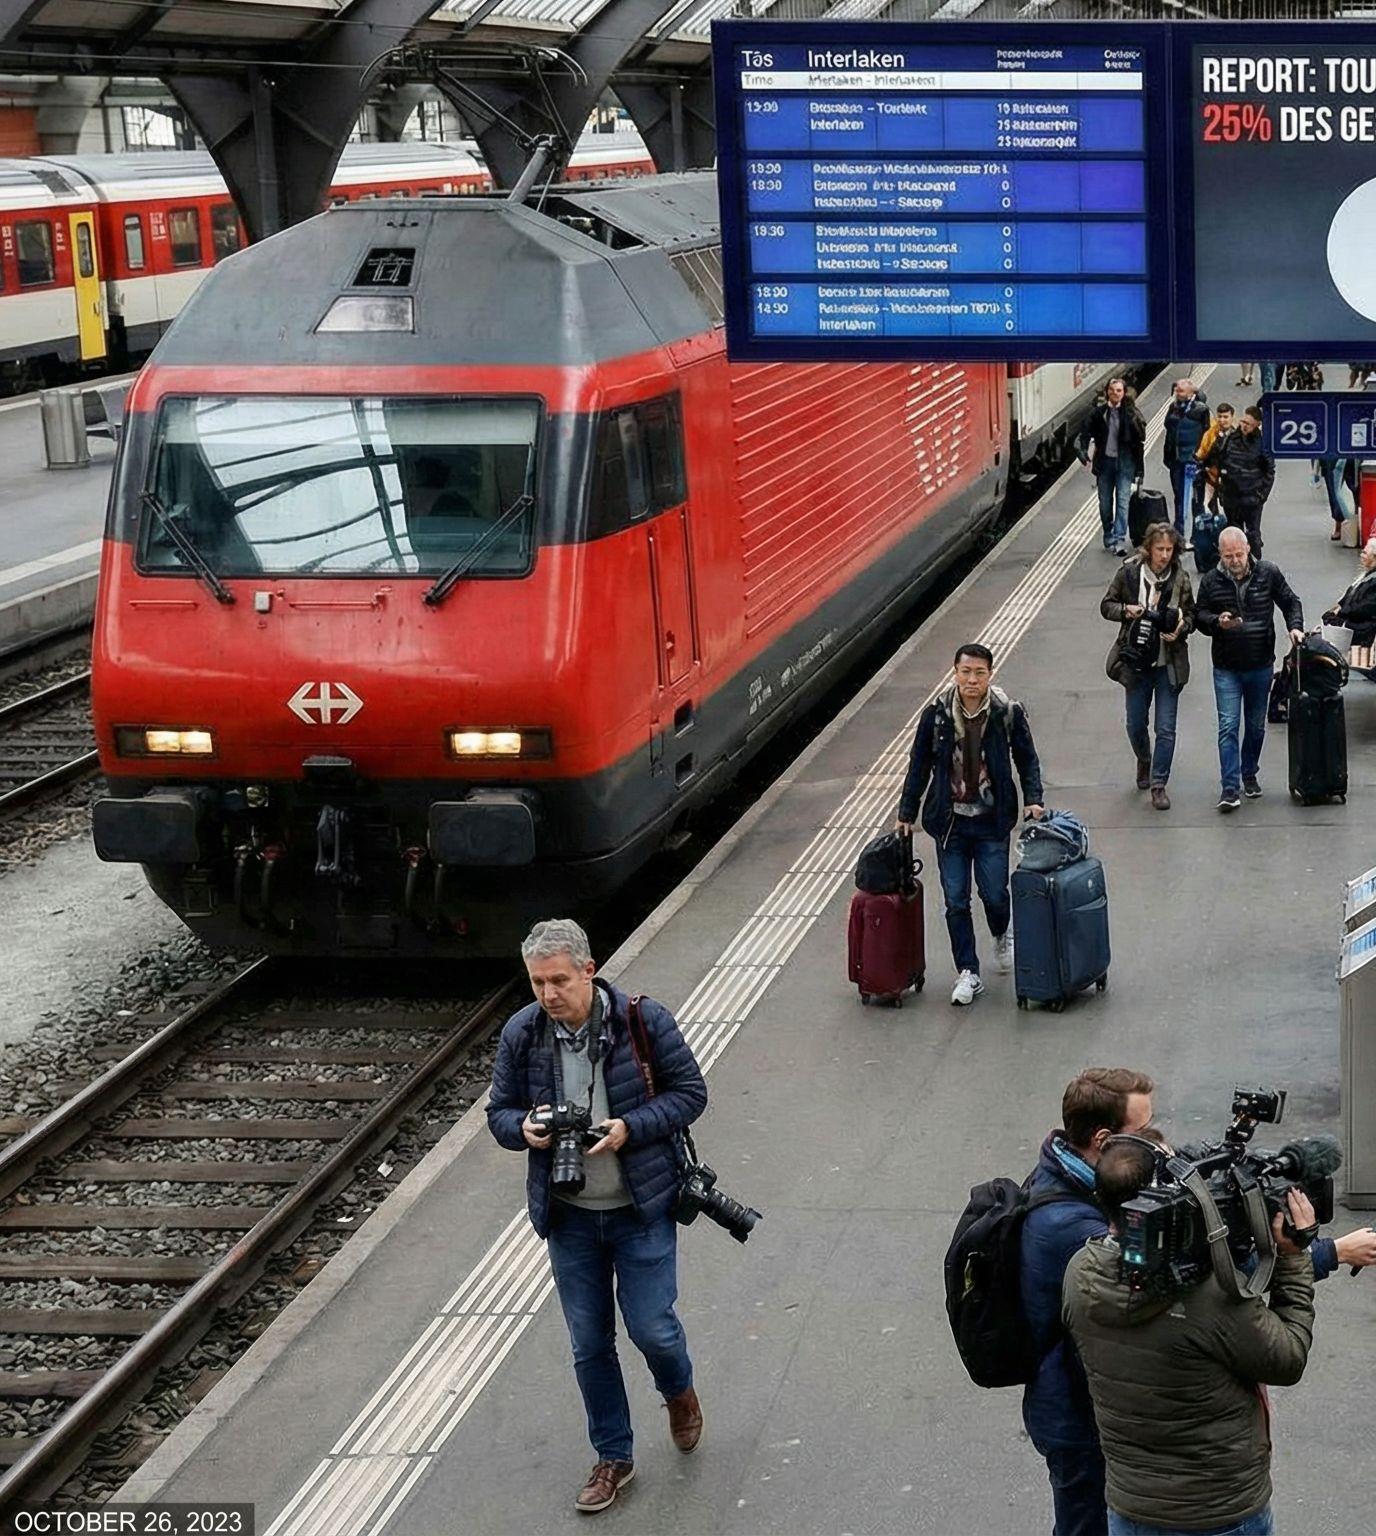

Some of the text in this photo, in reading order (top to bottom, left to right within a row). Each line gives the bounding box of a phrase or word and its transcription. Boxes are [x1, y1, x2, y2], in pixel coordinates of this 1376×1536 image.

[808, 50, 905, 68] Interlaken
[1202, 57, 1317, 94] REPORT:
[1202, 104, 1273, 143] 25%
[1279, 107, 1333, 142] DES
